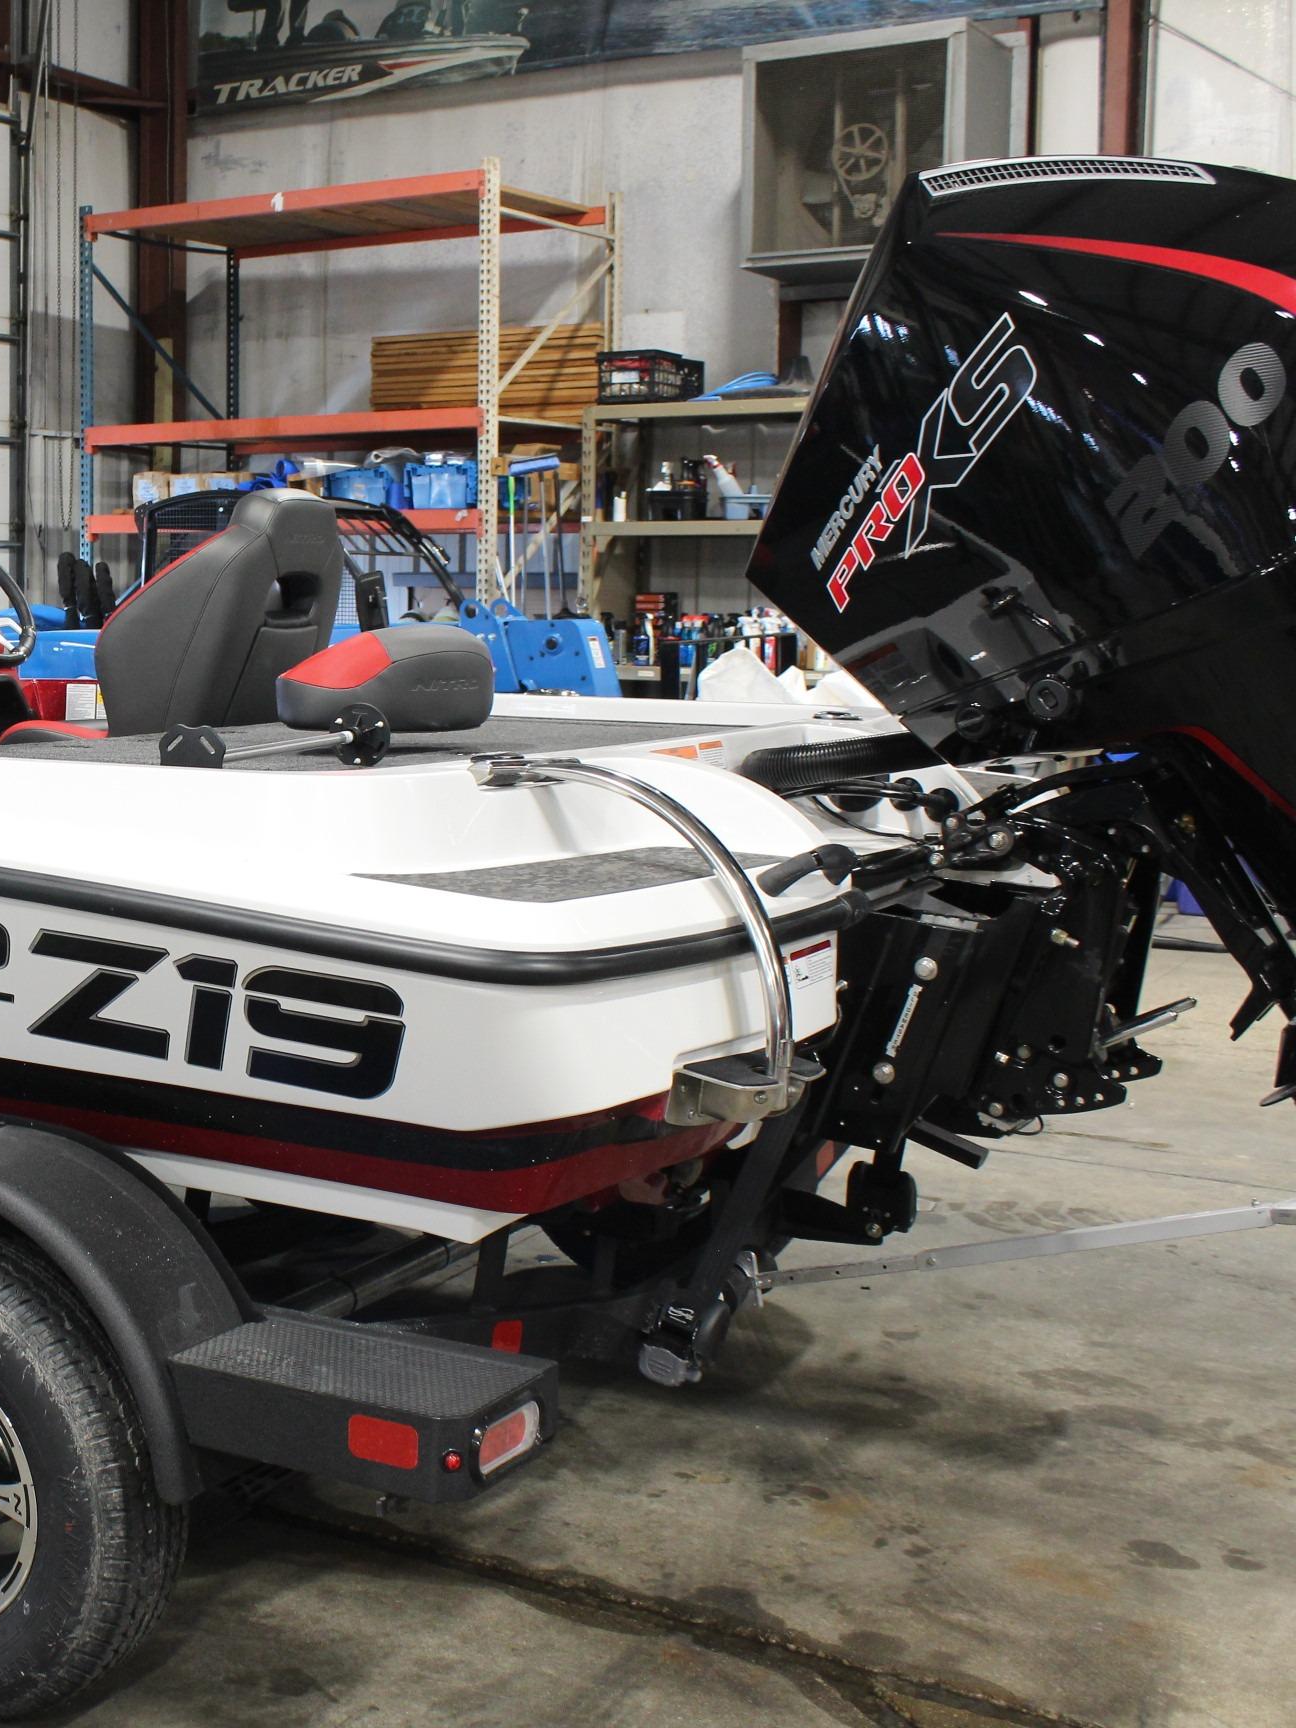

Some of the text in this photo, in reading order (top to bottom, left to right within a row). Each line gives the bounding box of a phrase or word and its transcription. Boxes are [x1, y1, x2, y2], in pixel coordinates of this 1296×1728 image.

[212, 63, 363, 105] TRACKER
[809, 444, 884, 572] MERCURY
[1105, 341, 1287, 560] 200
[826, 451, 926, 614] PRO
[26, 927, 408, 1101] Z19
